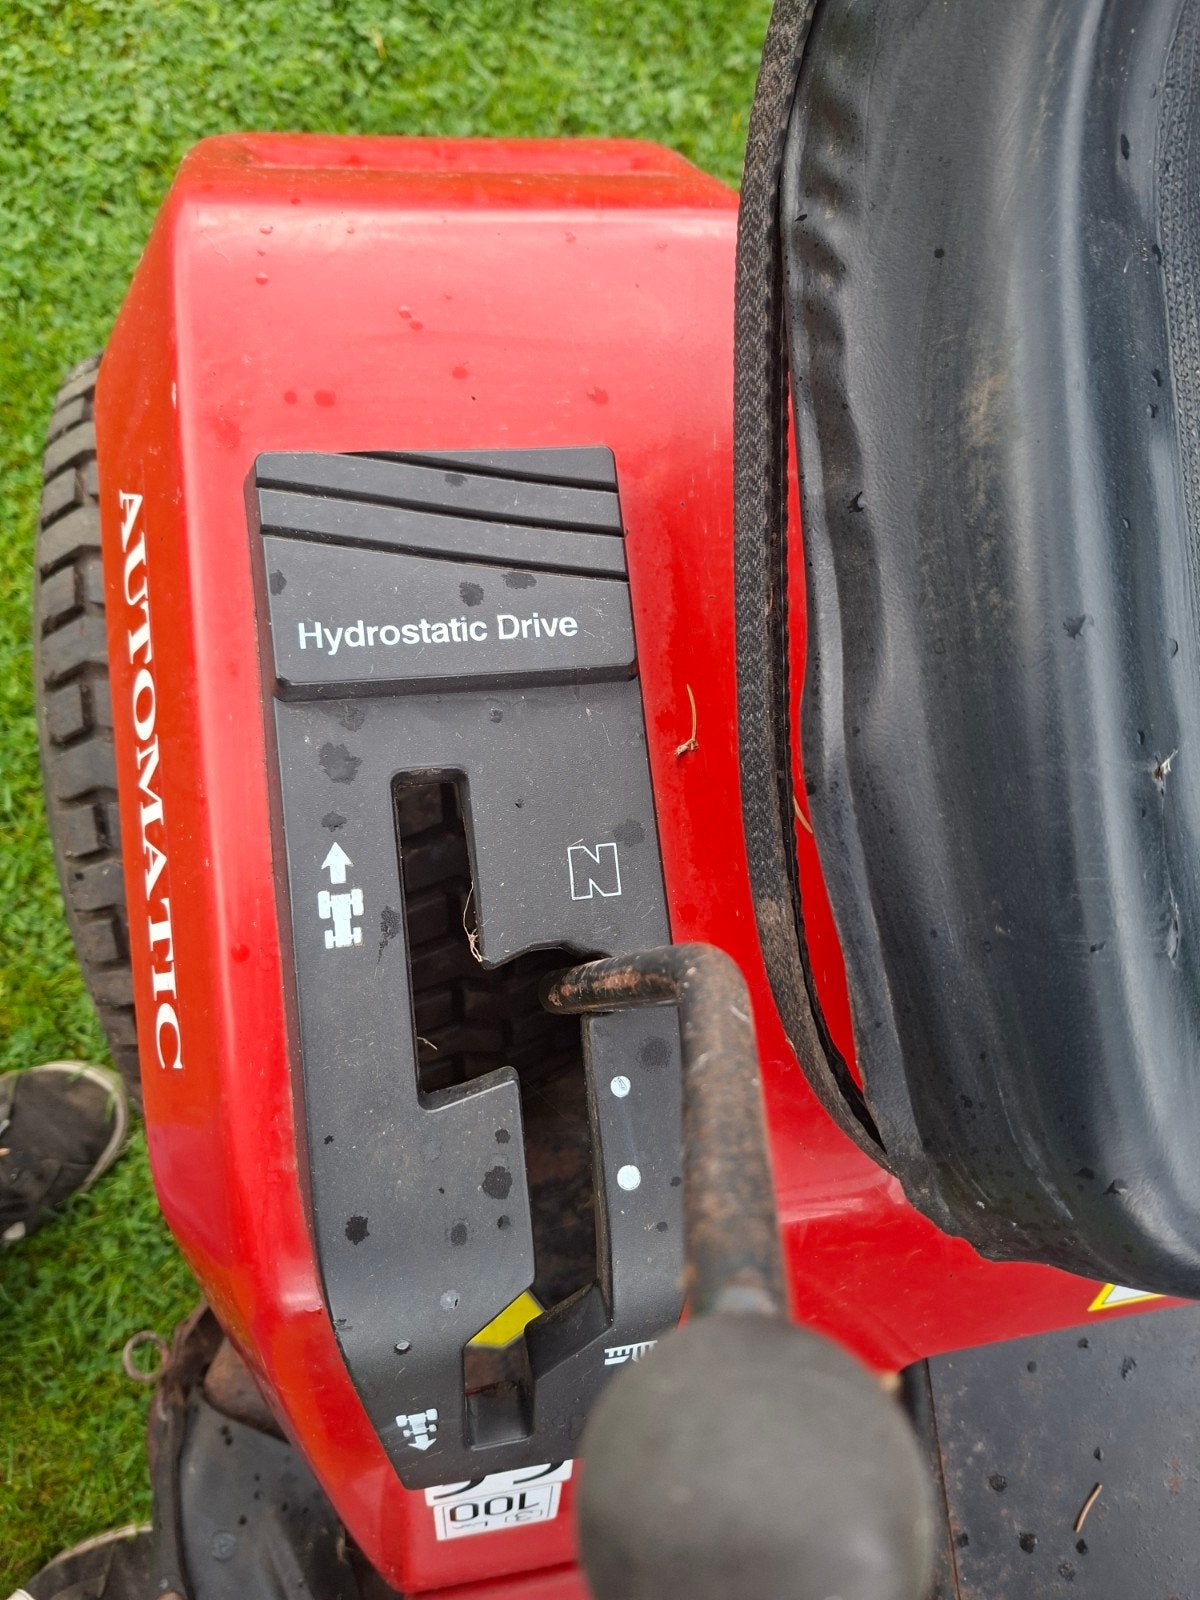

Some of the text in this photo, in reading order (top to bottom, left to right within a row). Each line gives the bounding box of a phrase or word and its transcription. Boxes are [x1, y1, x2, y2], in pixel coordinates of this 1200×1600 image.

[297, 611, 580, 656] Hydrostatic Drive
[117, 490, 184, 1071] AUTOMATIC
[567, 842, 622, 901] N
[449, 1492, 540, 1523] 100
